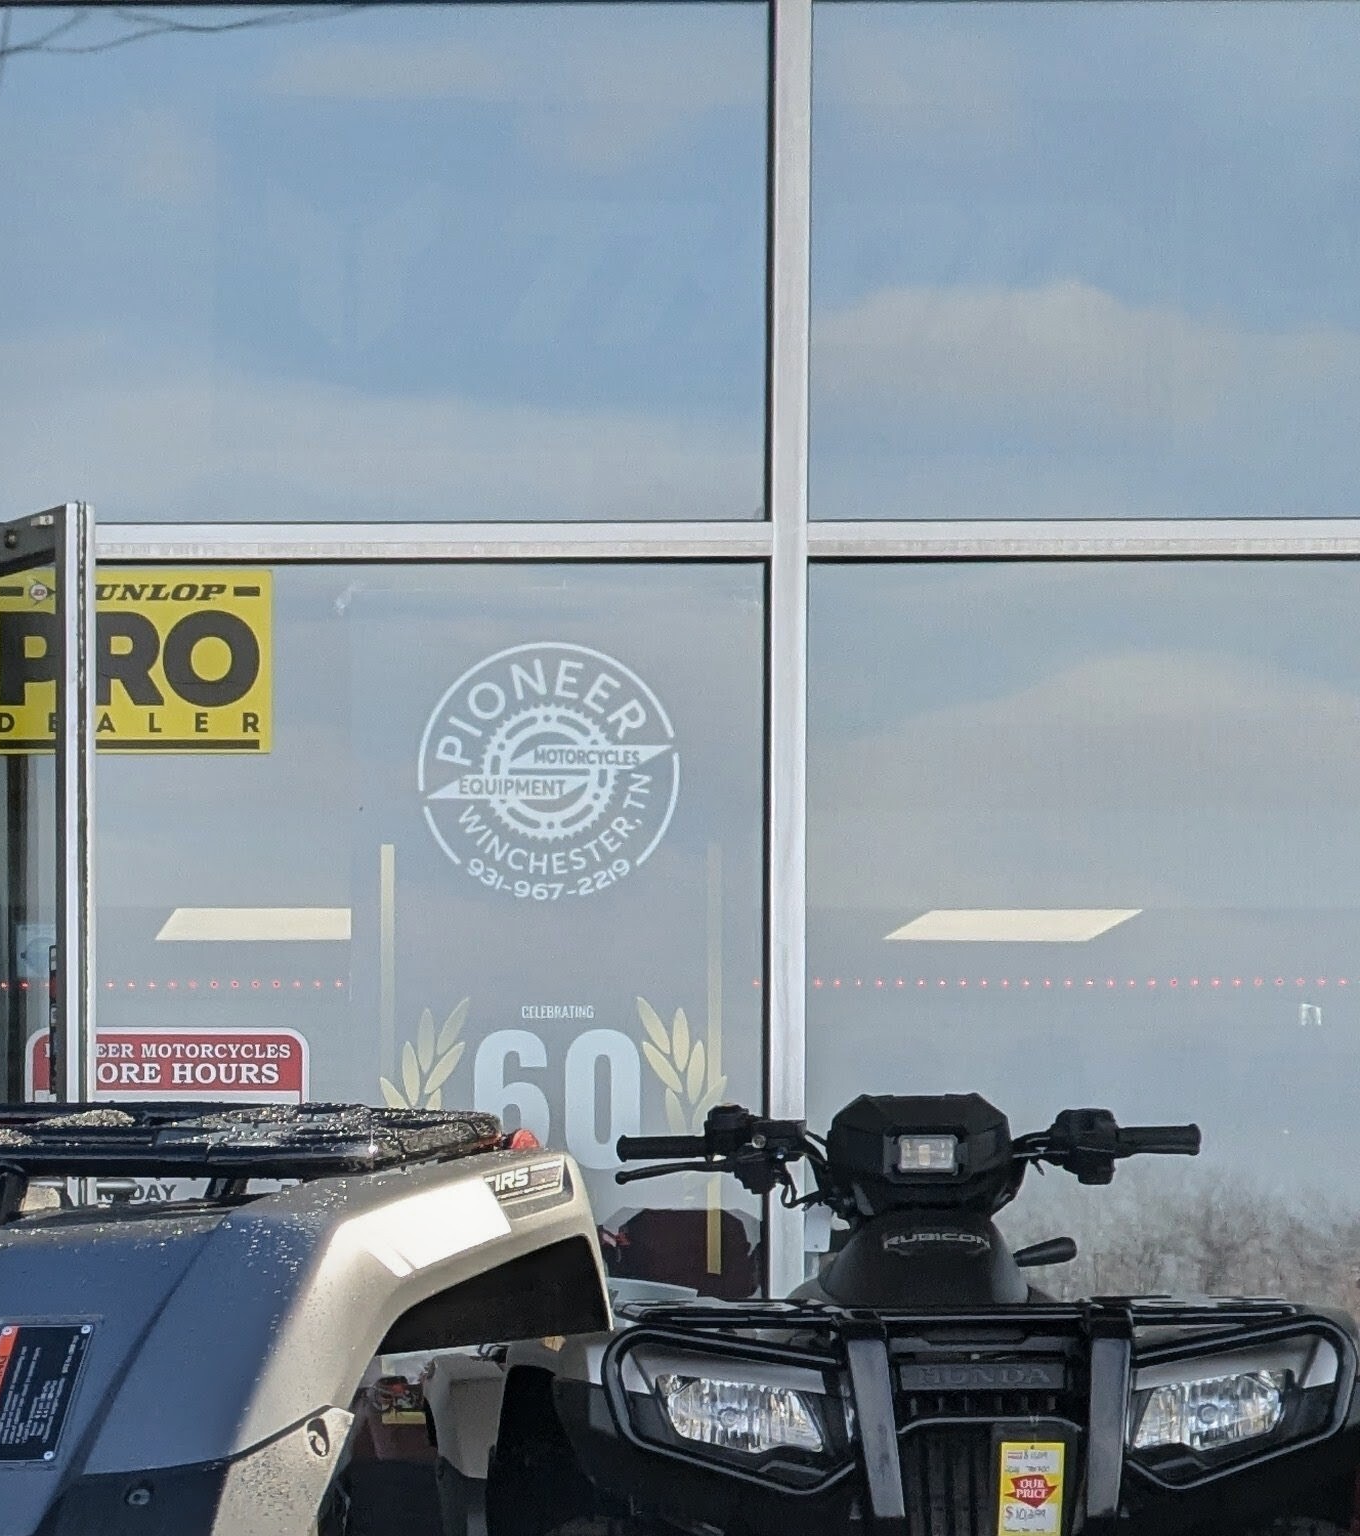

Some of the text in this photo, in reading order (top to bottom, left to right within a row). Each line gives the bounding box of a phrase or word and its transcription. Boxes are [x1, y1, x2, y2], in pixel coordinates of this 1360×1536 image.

[96, 583, 227, 601] UNLOP
[435, 658, 647, 767] PIONEER
[533, 748, 640, 766] MOTORCYCLES
[458, 778, 566, 797] EQUIPMENT
[622, 772, 653, 810] TN
[466, 857, 632, 901] 931-967-2219
[521, 1004, 595, 1020] CELEBRATING
[141, 1042, 291, 1059] MOTORCYCLES
[97, 1062, 280, 1084] ORE HOURS
[474, 1028, 642, 1170] 60
[918, 1366, 1052, 1386] HONDA
[1019, 1478, 1045, 1489] OUR
[1015, 1488, 1048, 1499] PRICE
